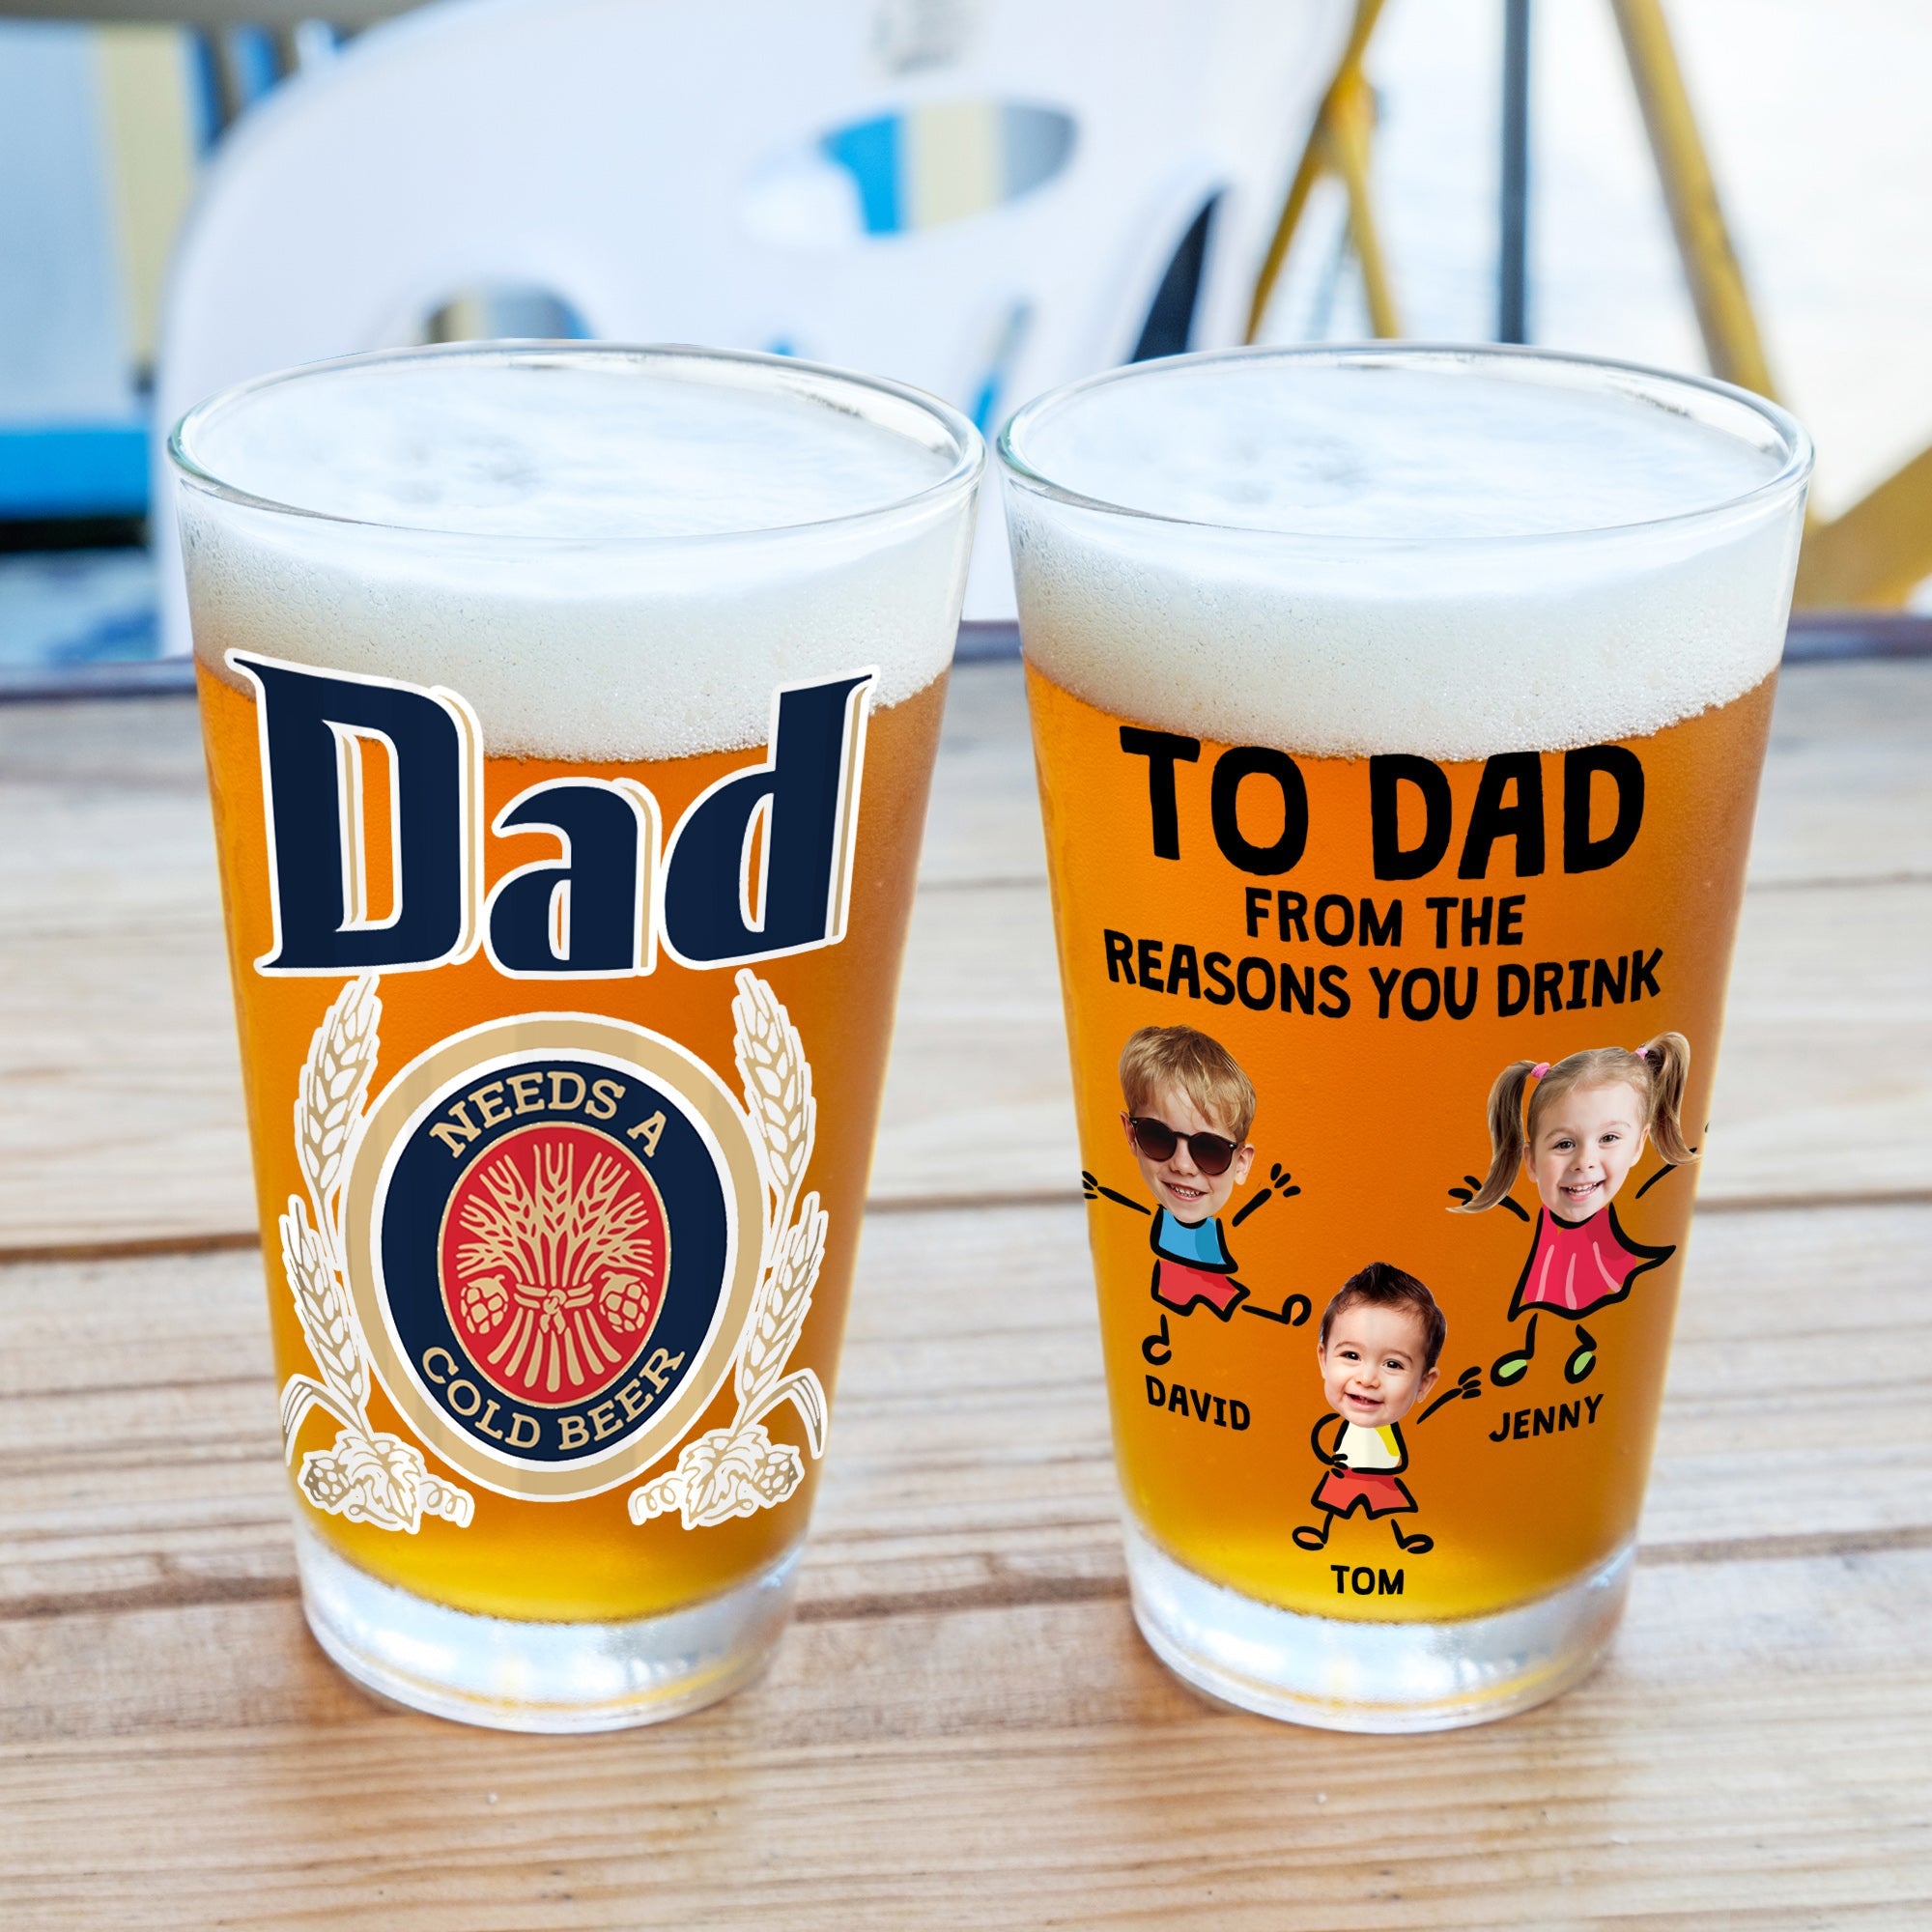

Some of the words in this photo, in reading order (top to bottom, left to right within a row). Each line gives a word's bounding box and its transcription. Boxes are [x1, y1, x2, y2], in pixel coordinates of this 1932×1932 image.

[225, 648, 880, 980] Dad
[1119, 725, 1309, 876] TO
[1369, 744, 1646, 881] DAD
[1244, 886, 1403, 947] FROM
[1425, 894, 1526, 949] THE
[1103, 928, 1351, 1019] REASONS
[1368, 966, 1478, 1021] YOU
[1497, 947, 1664, 1017] DRINK
[429, 1070, 626, 1158] NEEDS
[626, 1110, 668, 1157] A
[421, 1346, 542, 1449] COLD
[557, 1347, 686, 1451] BEER
[1146, 1375, 1251, 1432] DAVID
[1488, 1393, 1605, 1443] JENNY
[1330, 1564, 1406, 1596] TOM
